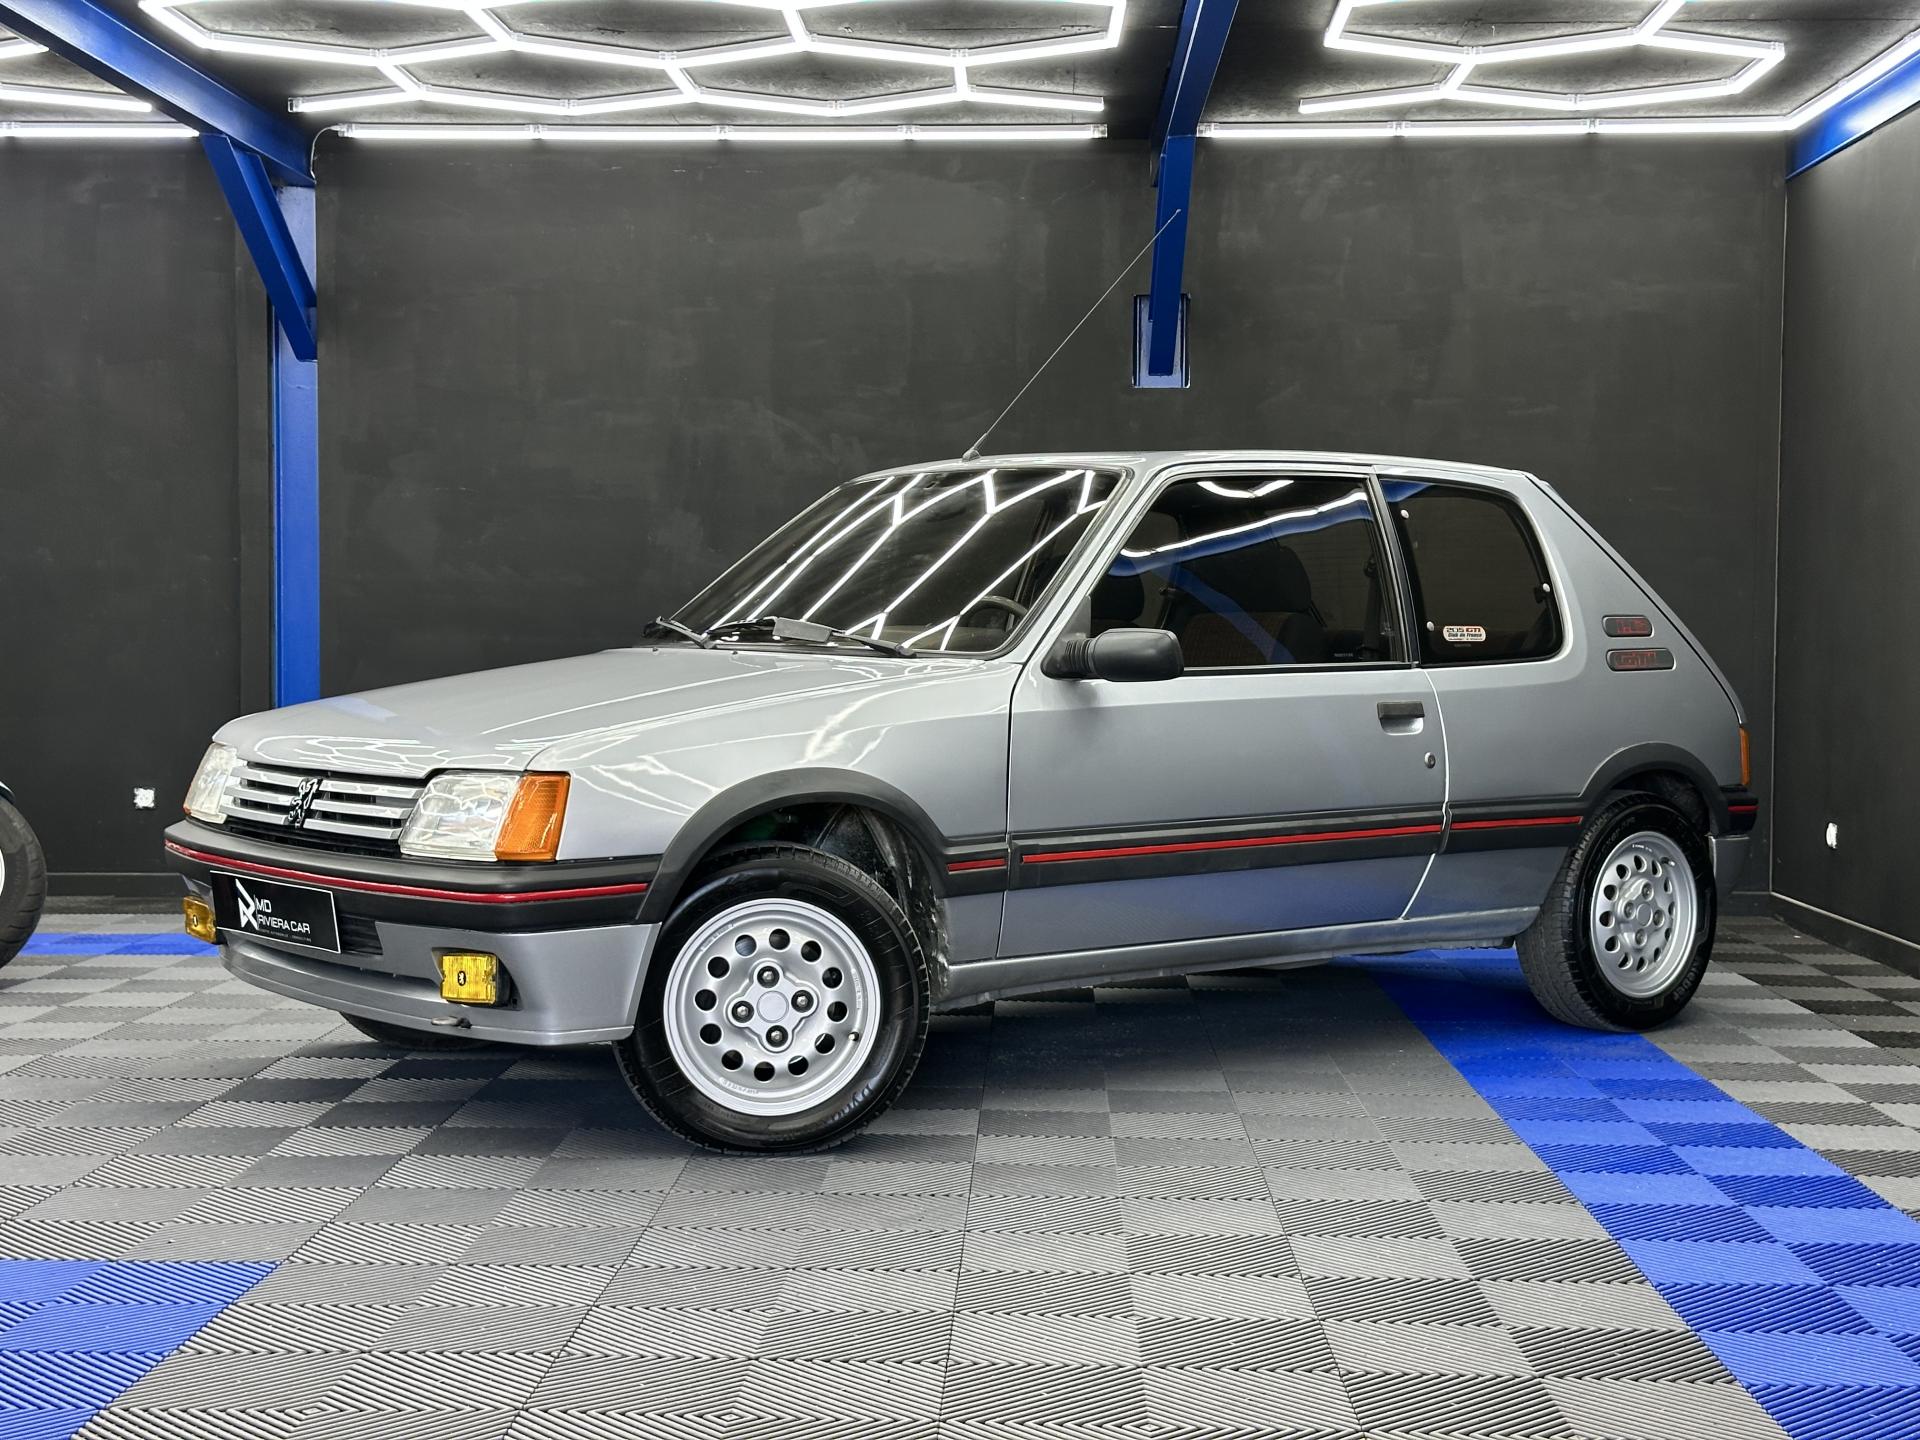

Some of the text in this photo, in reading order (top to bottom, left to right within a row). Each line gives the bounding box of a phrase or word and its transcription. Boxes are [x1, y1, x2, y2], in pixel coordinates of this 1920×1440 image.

[255, 897, 272, 913] MD
[257, 914, 311, 934] RIVIERA CAR
